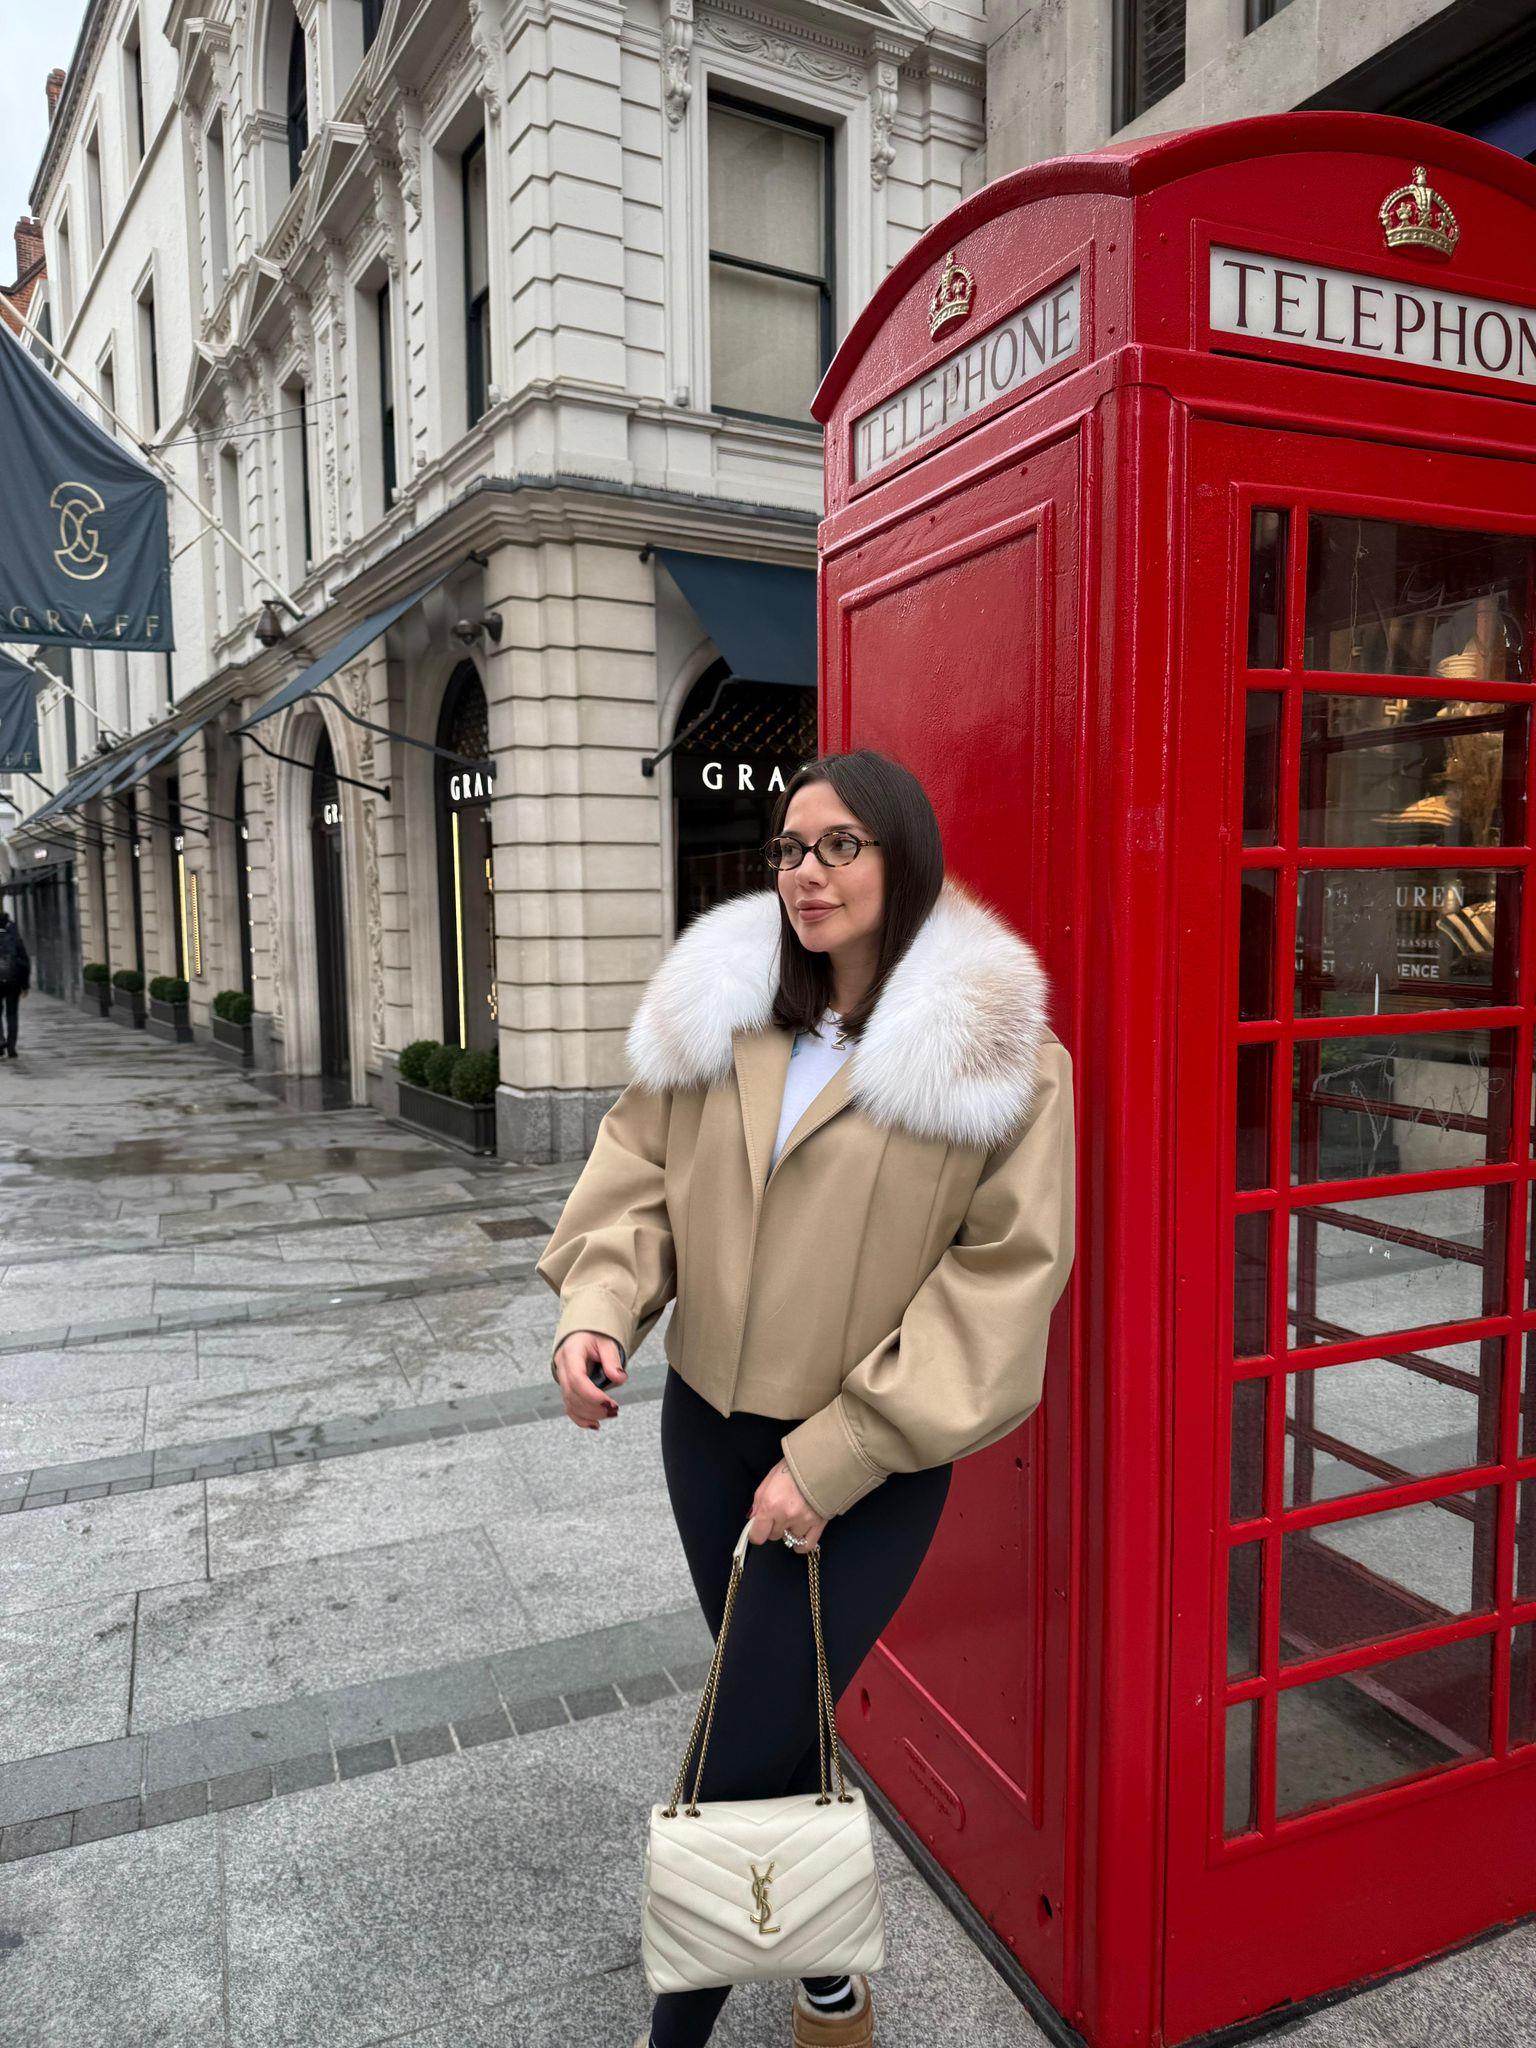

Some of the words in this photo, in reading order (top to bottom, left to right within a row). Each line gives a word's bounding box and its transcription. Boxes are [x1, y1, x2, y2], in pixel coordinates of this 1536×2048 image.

[1222, 259, 1536, 377] TELEPHON
[861, 285, 1075, 471] TELEPHONE
[9, 605, 160, 637] GRAFF
